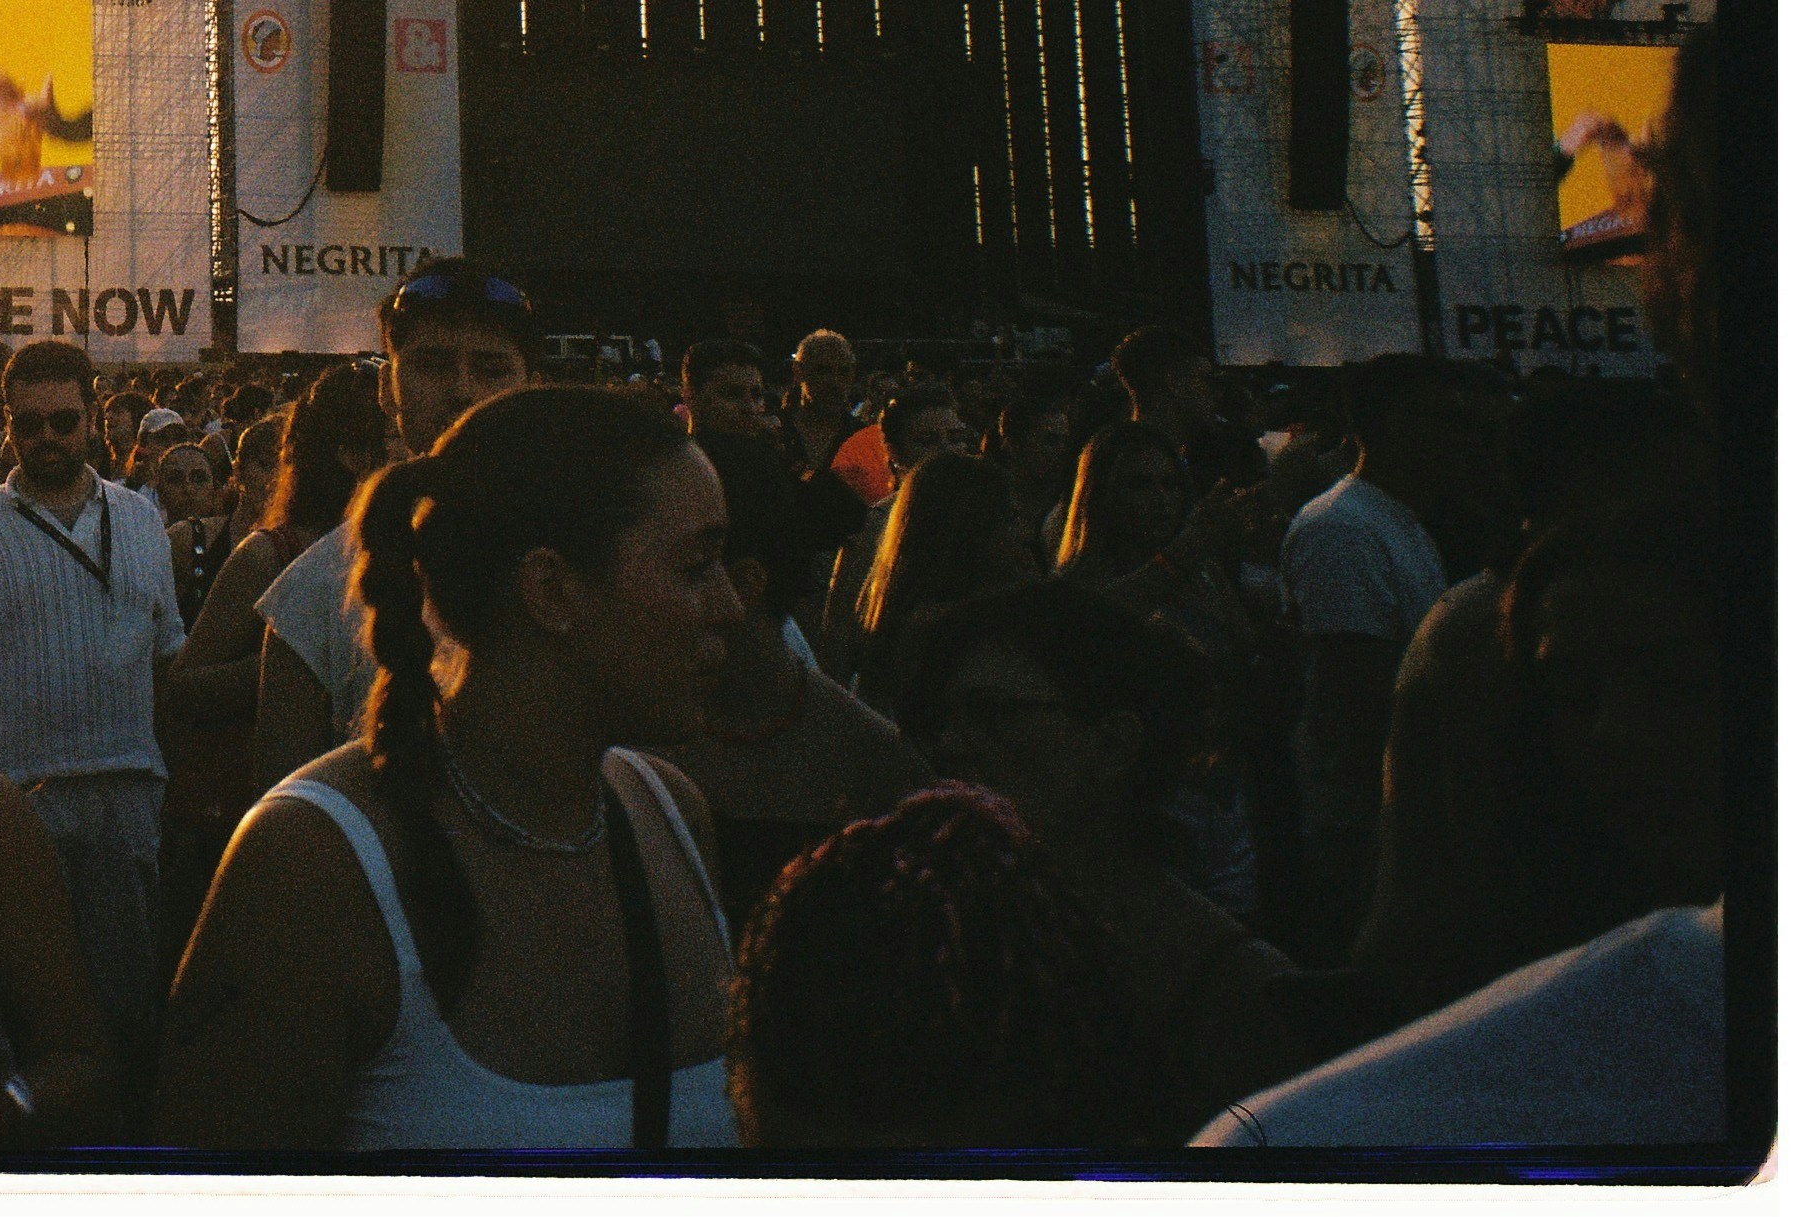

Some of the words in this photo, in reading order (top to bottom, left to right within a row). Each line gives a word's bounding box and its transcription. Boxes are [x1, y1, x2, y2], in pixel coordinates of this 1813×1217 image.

[1229, 261, 1397, 292] NEGRITA
[52, 287, 196, 336] NOW
[1455, 304, 1637, 352] PEACE
